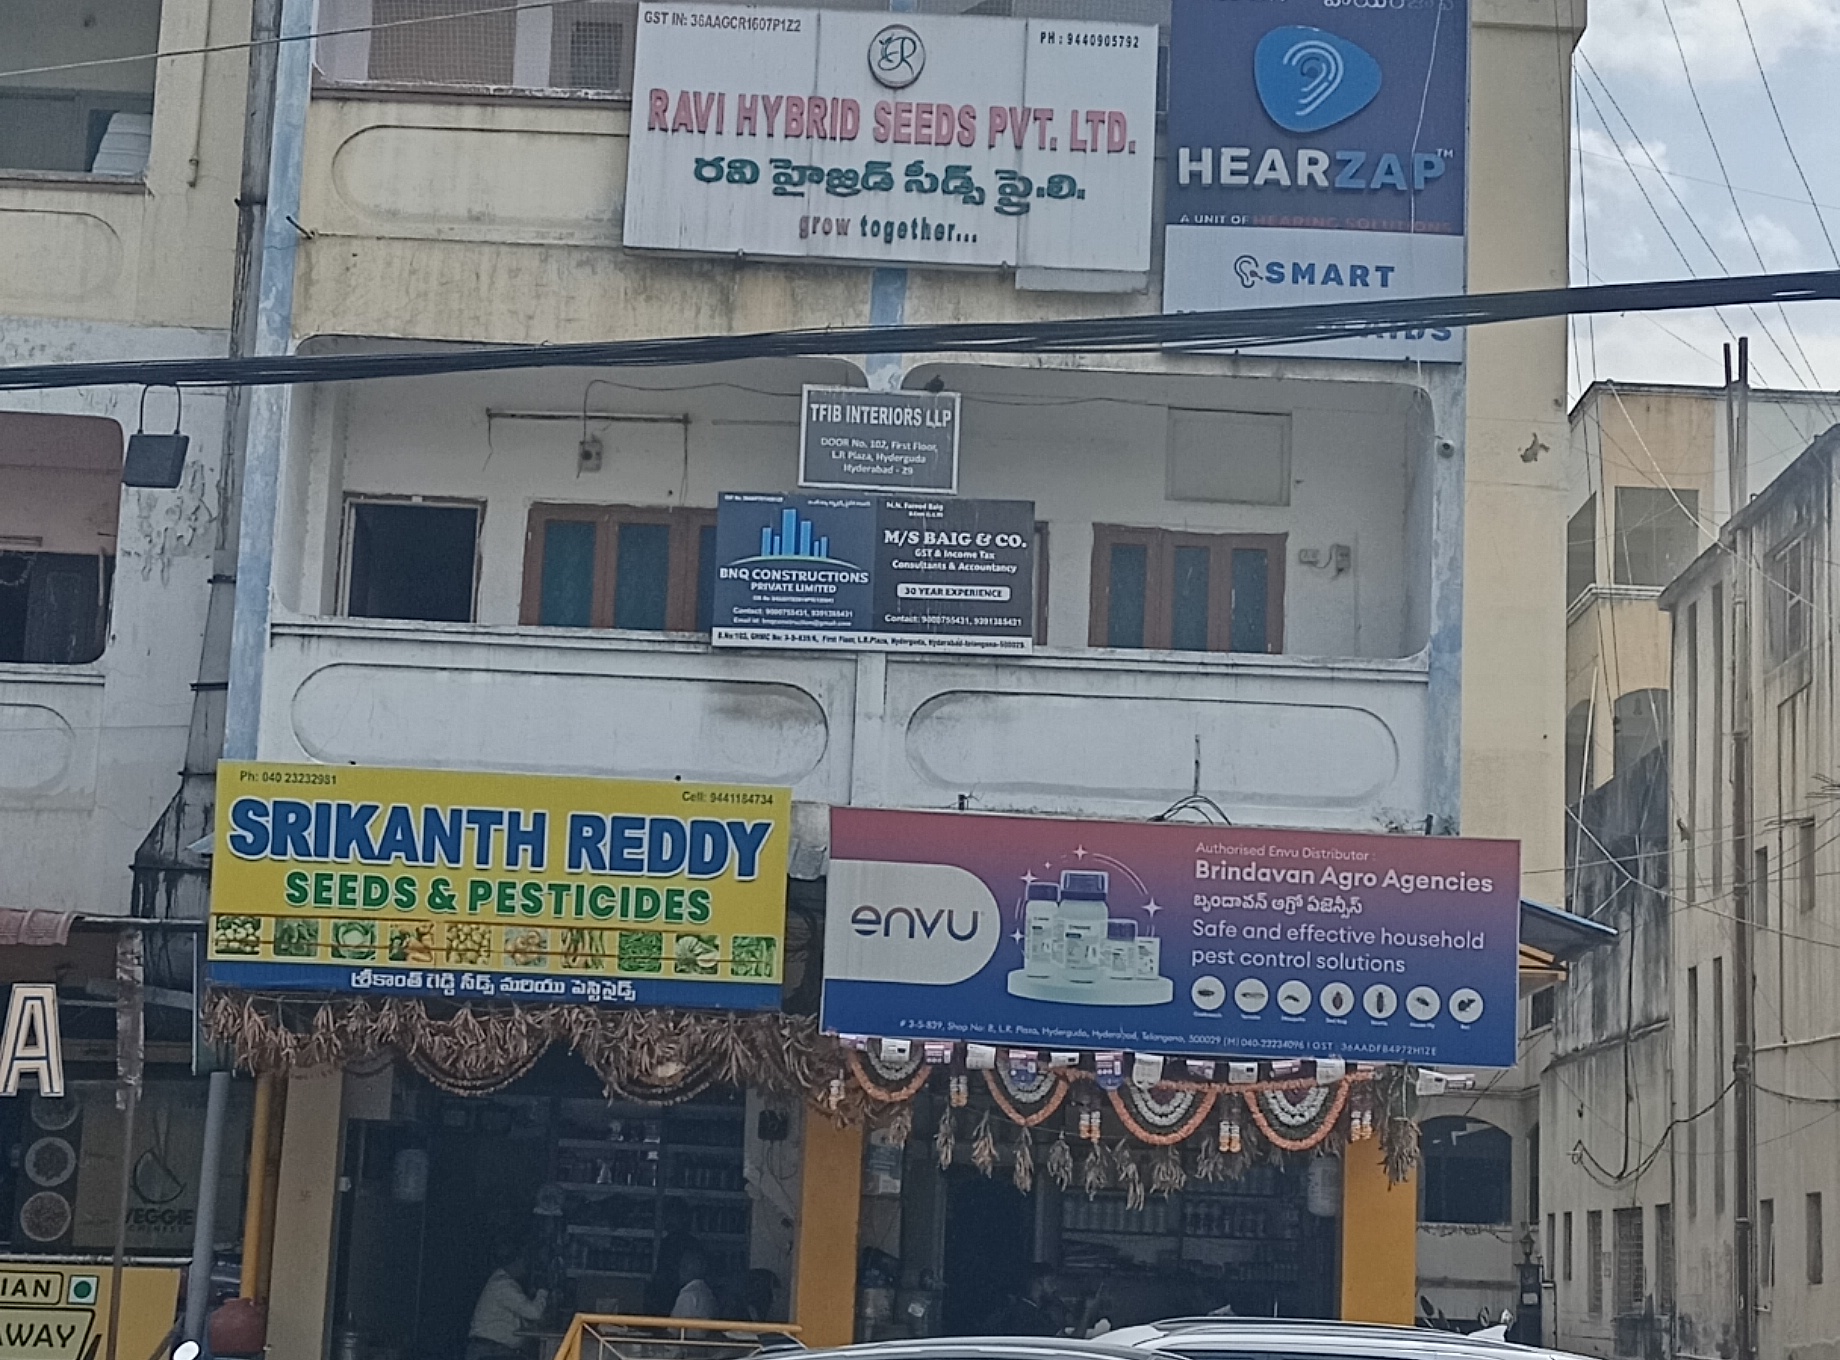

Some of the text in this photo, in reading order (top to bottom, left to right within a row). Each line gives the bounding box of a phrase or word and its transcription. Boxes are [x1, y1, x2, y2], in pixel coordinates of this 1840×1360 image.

[644, 10, 669, 25] GST
[648, 87, 1137, 155] RAVI HYBRID SEEDS PVT. LTD.
[694, 156, 760, 185] రవి
[1177, 146, 1447, 192] HEARZAP
[798, 213, 978, 244] grow together...
[1179, 214, 1190, 224] A
[1193, 214, 1227, 225] UNIT
[1230, 215, 1249, 226] OF
[1252, 215, 1338, 228] HEARING
[1264, 261, 1396, 289] SMART
[809, 403, 952, 429] TFIB INTERIORS LLP
[820, 437, 850, 448] DOOR
[890, 441, 912, 451] First
[843, 463, 894, 475] Hyderabad
[875, 453, 927, 464] Hyderguda
[883, 529, 1028, 549] M/S BAIG & CO.
[914, 548, 996, 560] GST & Income Tax
[719, 567, 870, 583] BNQ CONSTRUCTIONS
[892, 559, 1018, 574] Consultants & Accountancy
[750, 581, 837, 593] PRIVATE LIMITED
[904, 586, 1003, 599] 30 YEAR EXPERIENCE
[239, 770, 259, 782] Ph:
[262, 771, 282, 784] 040
[228, 797, 773, 882] SRIKANTH REDDY
[1195, 842, 1266, 858] Authorised
[1268, 845, 1300, 859] Envu
[1302, 846, 1370, 862] Distributor
[1194, 859, 1494, 895] Brindavan Agro Agencies
[285, 870, 712, 923] SEEDS & PESTICIDES
[851, 904, 980, 942] envu
[1192, 919, 1485, 951] Safe and effective household
[1190, 948, 1407, 973] pest control solutions
[0, 982, 65, 1098] A
[947, 1022, 968, 1033] Shop
[1042, 1027, 1090, 1039] Hyderguda,
[0, 1323, 76, 1349] WAY
